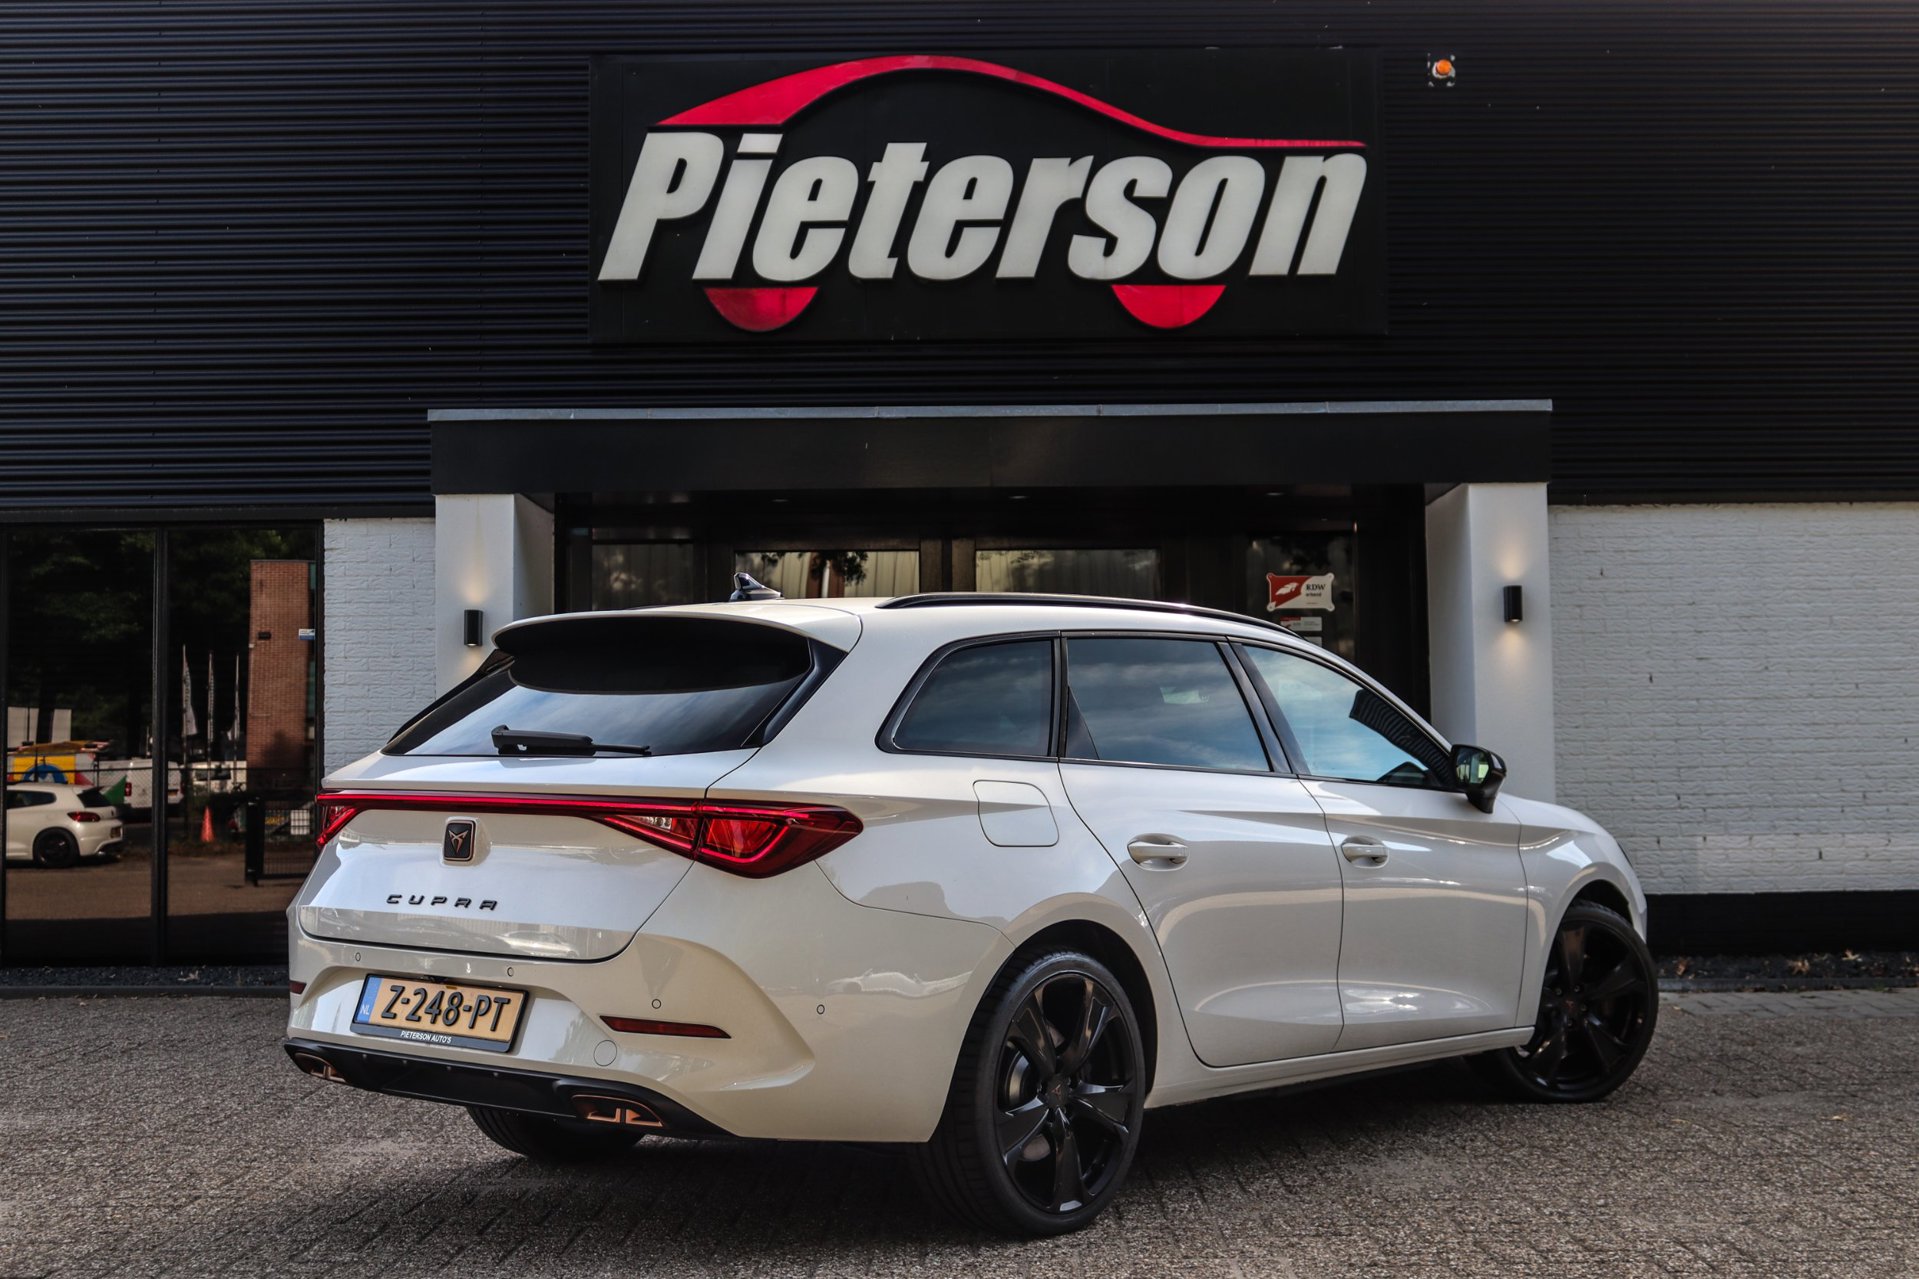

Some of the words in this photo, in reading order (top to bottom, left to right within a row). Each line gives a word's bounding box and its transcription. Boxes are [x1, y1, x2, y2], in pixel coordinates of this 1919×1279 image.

[597, 131, 1368, 282] Pieterson
[386, 894, 498, 911] CUPRA
[360, 1004, 370, 1015] NL
[381, 985, 511, 1032] Z-248-PT
[401, 1031, 431, 1041] PIETERSON
[431, 1035, 452, 1043] AUTO'S
